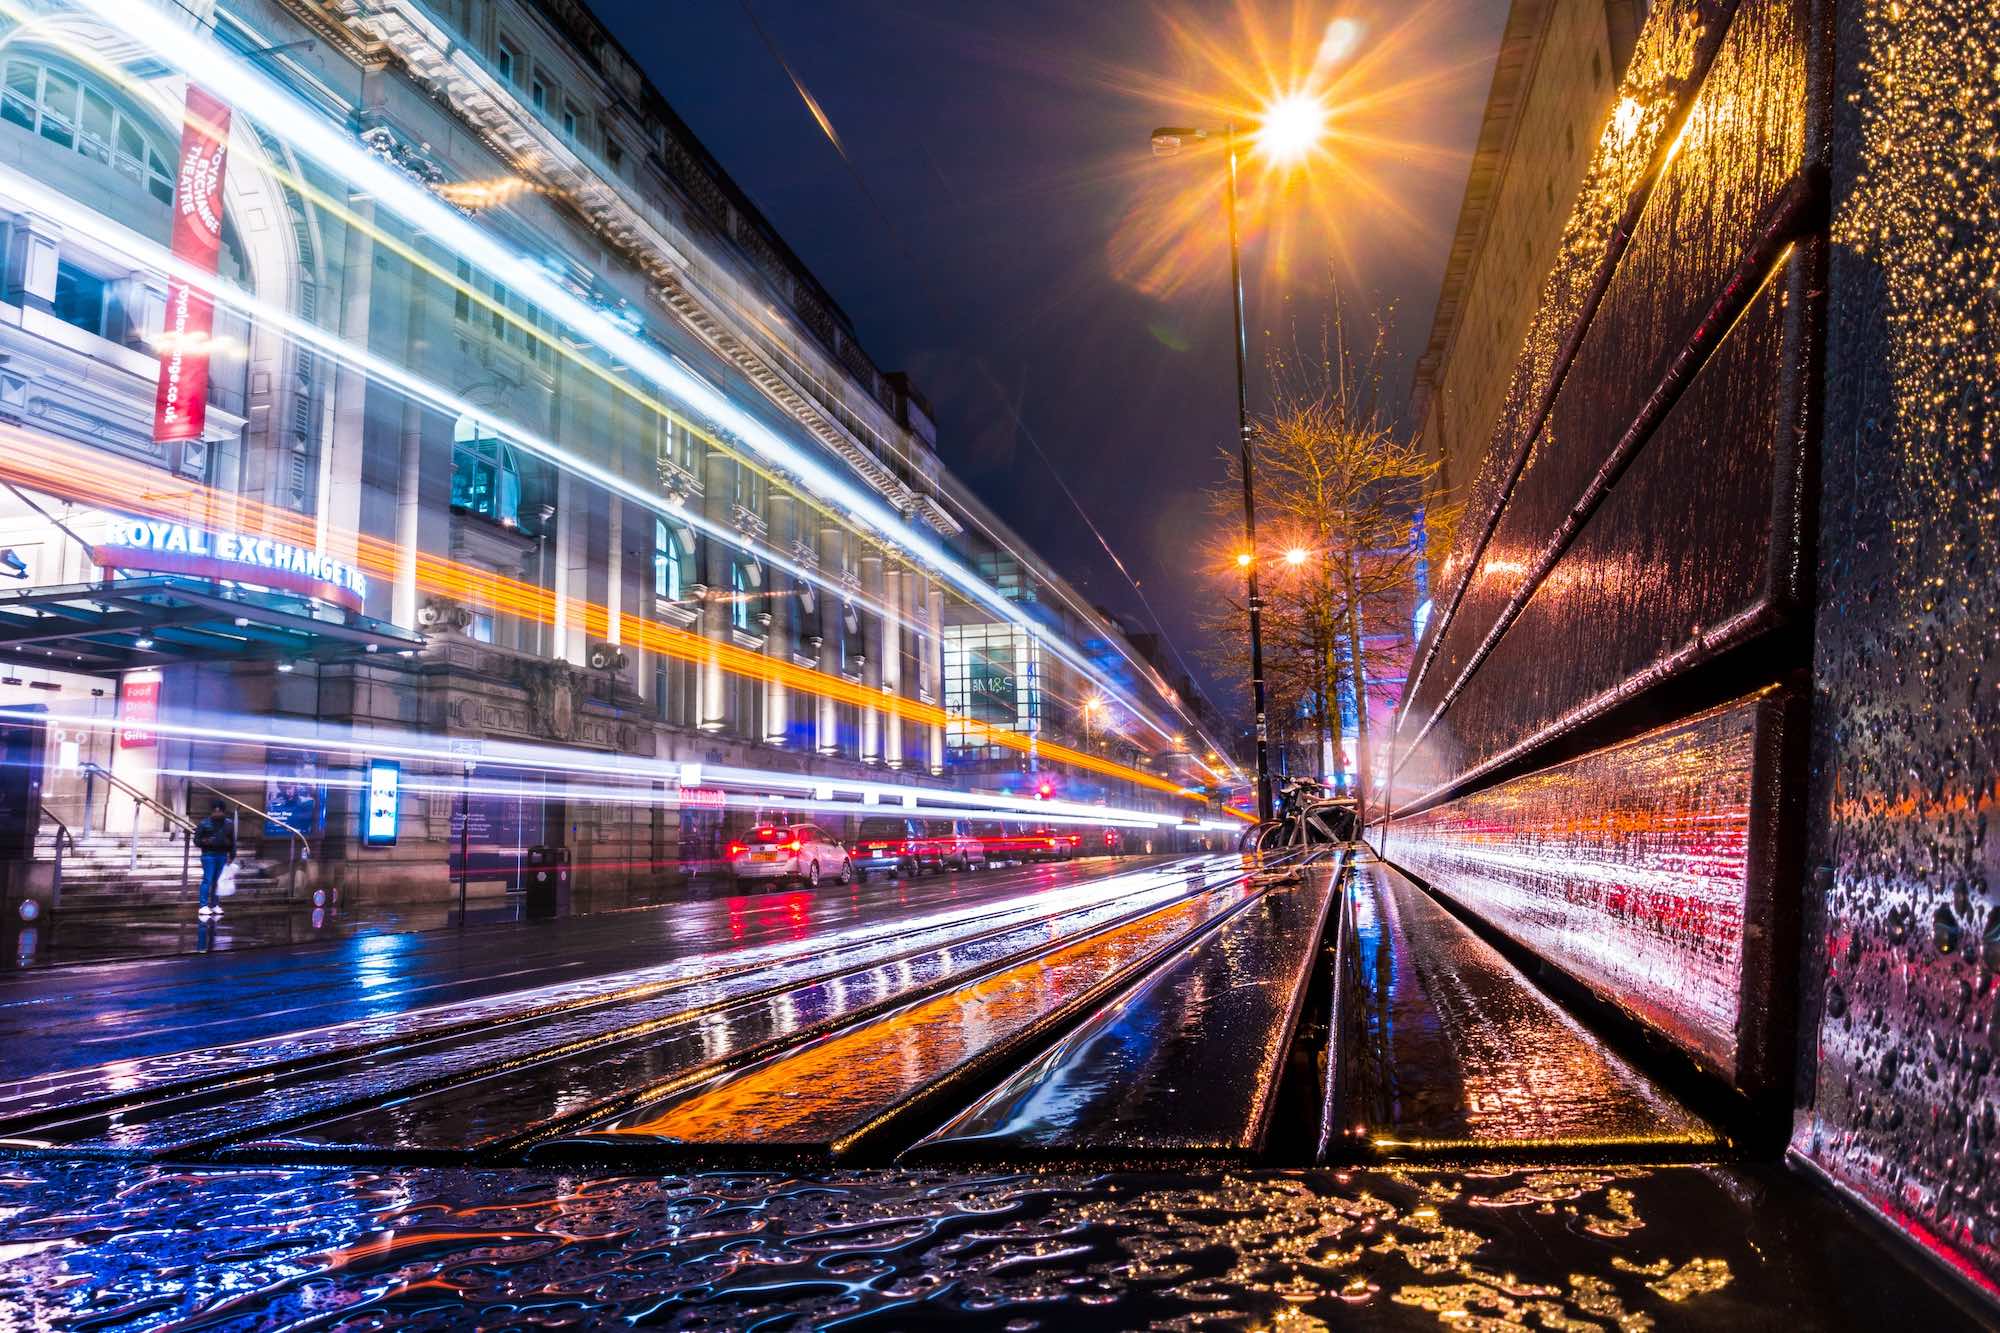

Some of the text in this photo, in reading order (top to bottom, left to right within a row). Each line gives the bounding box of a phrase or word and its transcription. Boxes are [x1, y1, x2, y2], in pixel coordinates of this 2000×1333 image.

[179, 145, 203, 215] THEATRE
[193, 157, 220, 234] EXCHANGE
[206, 143, 227, 196] ROYAL
[164, 284, 189, 424] royalexnge.co.uk
[104, 519, 208, 554] ROYAL
[217, 532, 342, 586] EXCHANGE
